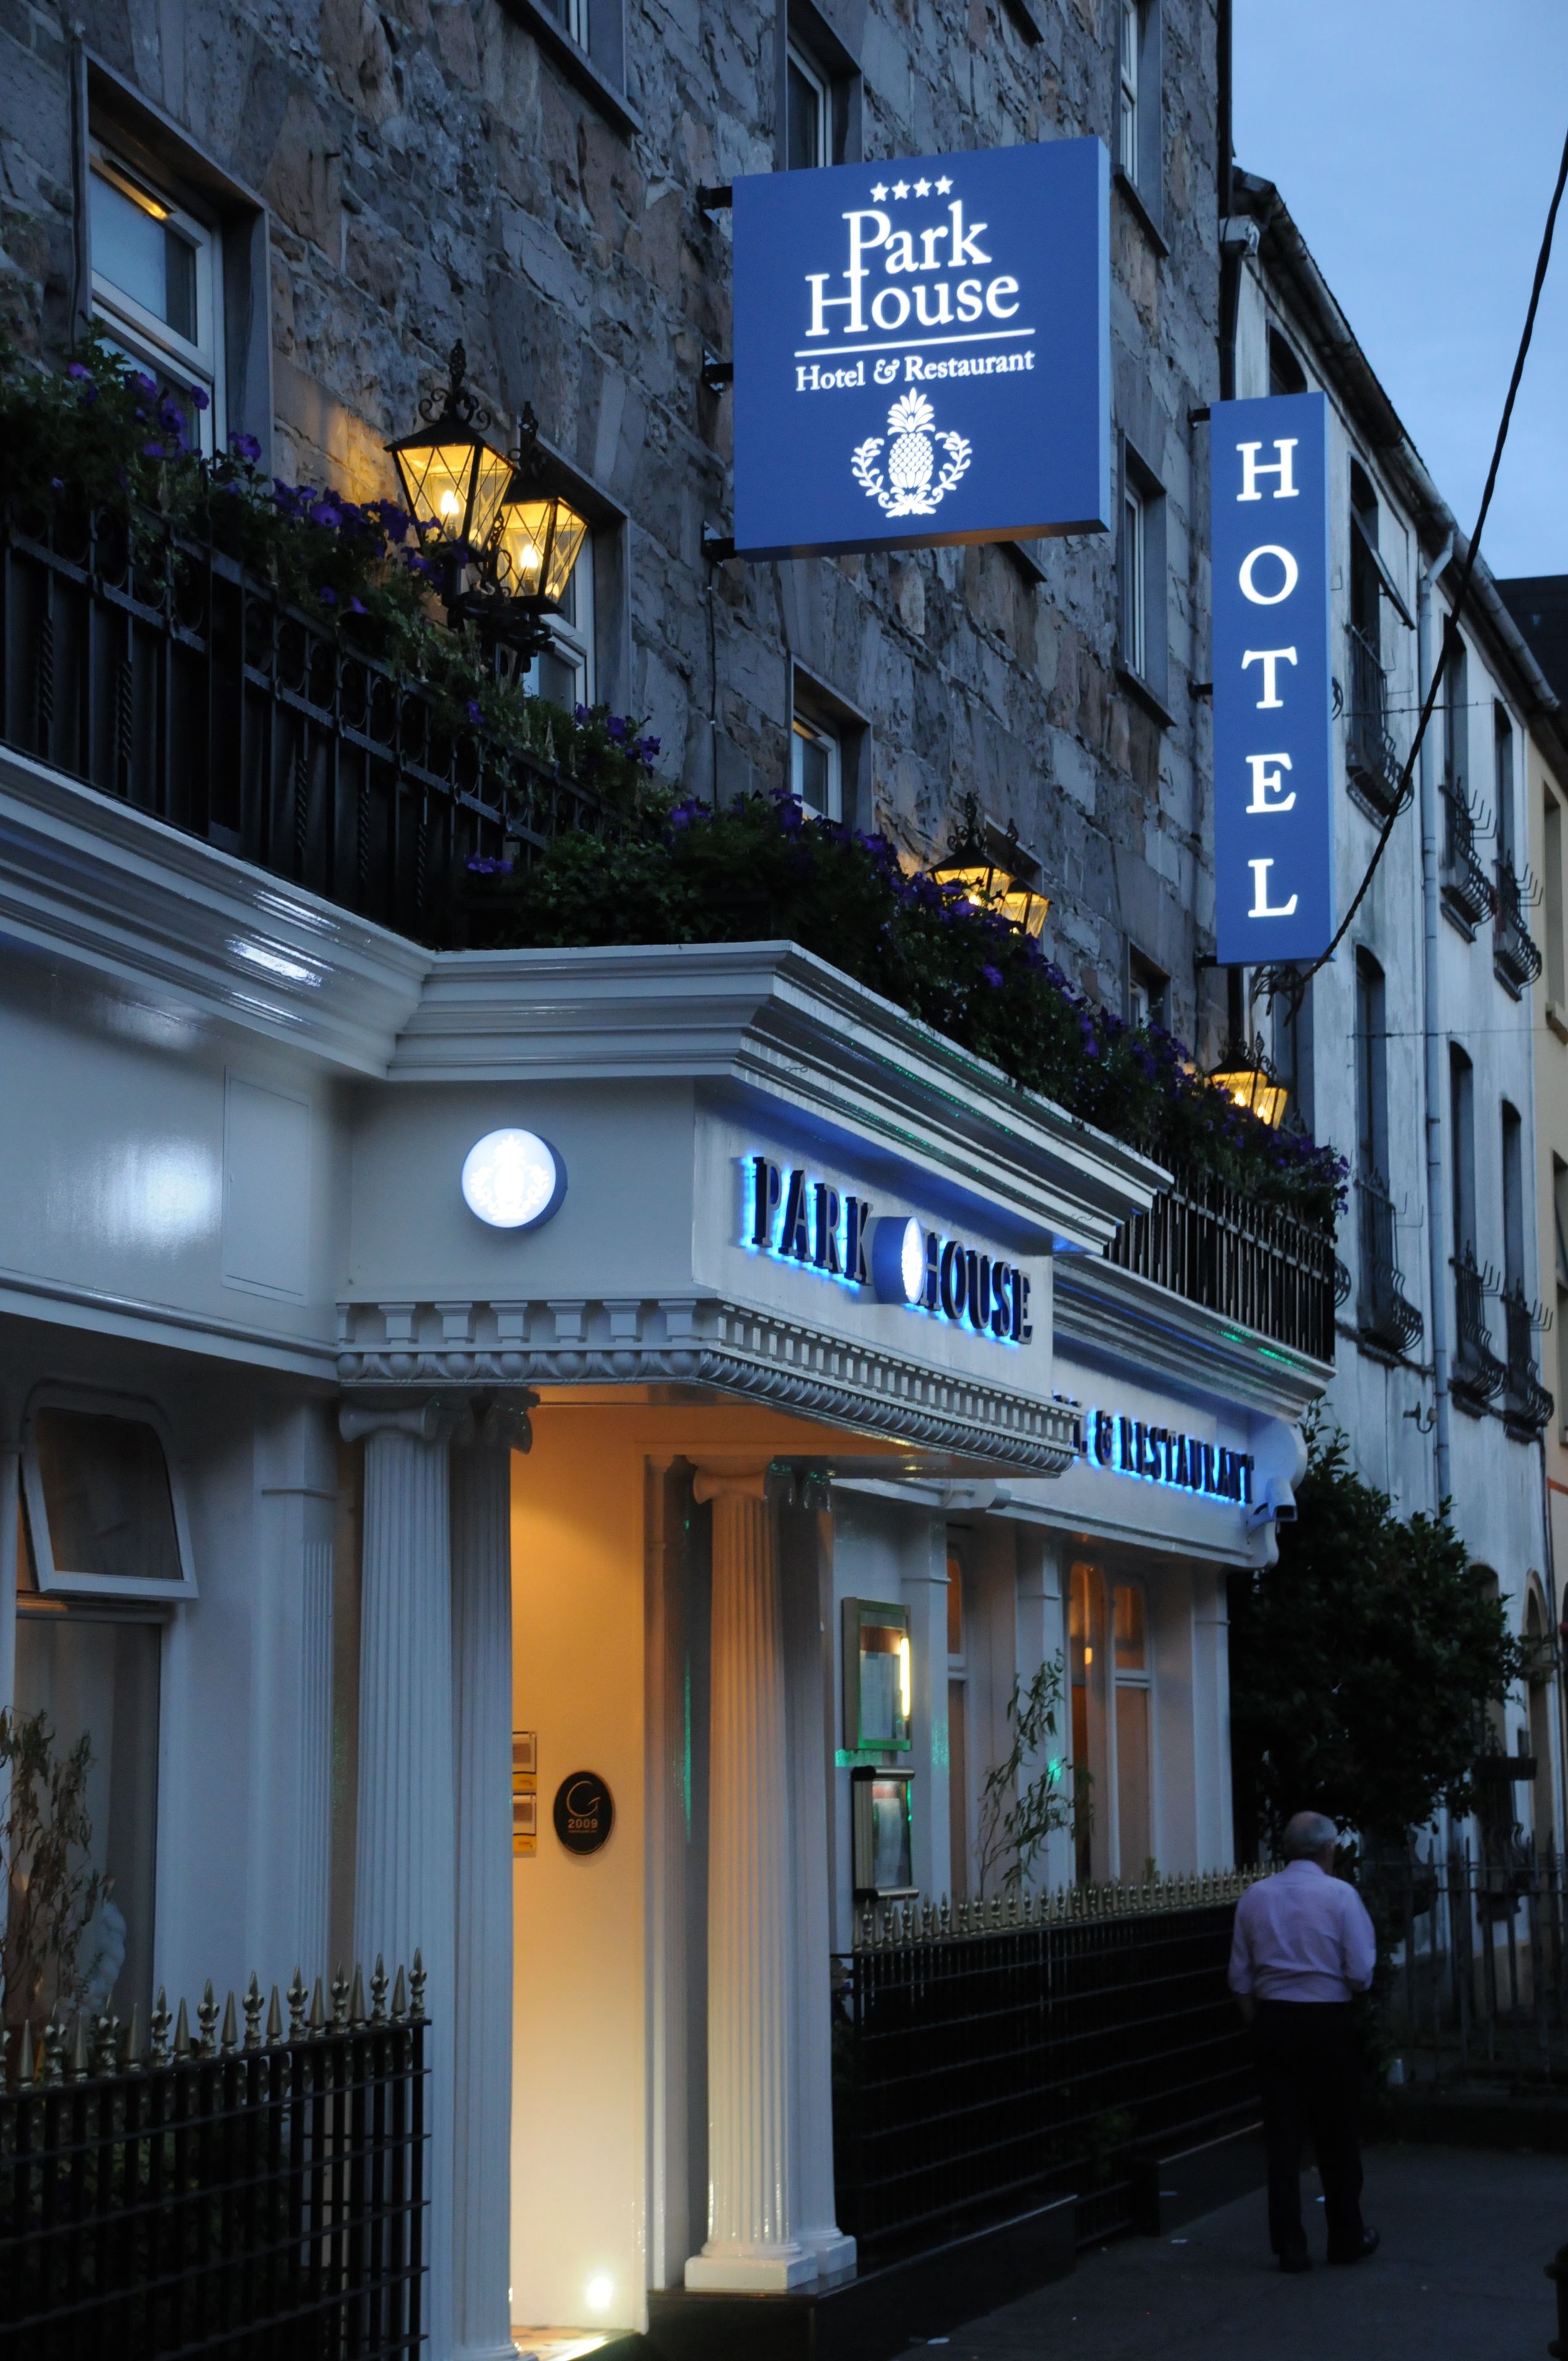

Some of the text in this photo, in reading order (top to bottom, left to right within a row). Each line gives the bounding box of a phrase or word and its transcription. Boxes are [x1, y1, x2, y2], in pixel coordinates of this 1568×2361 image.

[842, 200, 992, 276] Park
[805, 271, 1020, 337] House
[794, 349, 1035, 392] Hotel & Restaurant
[1236, 438, 1299, 918] HOTEL
[751, 1156, 1034, 1345] PARK HOUSE
[568, 1818, 598, 1829] 2009
